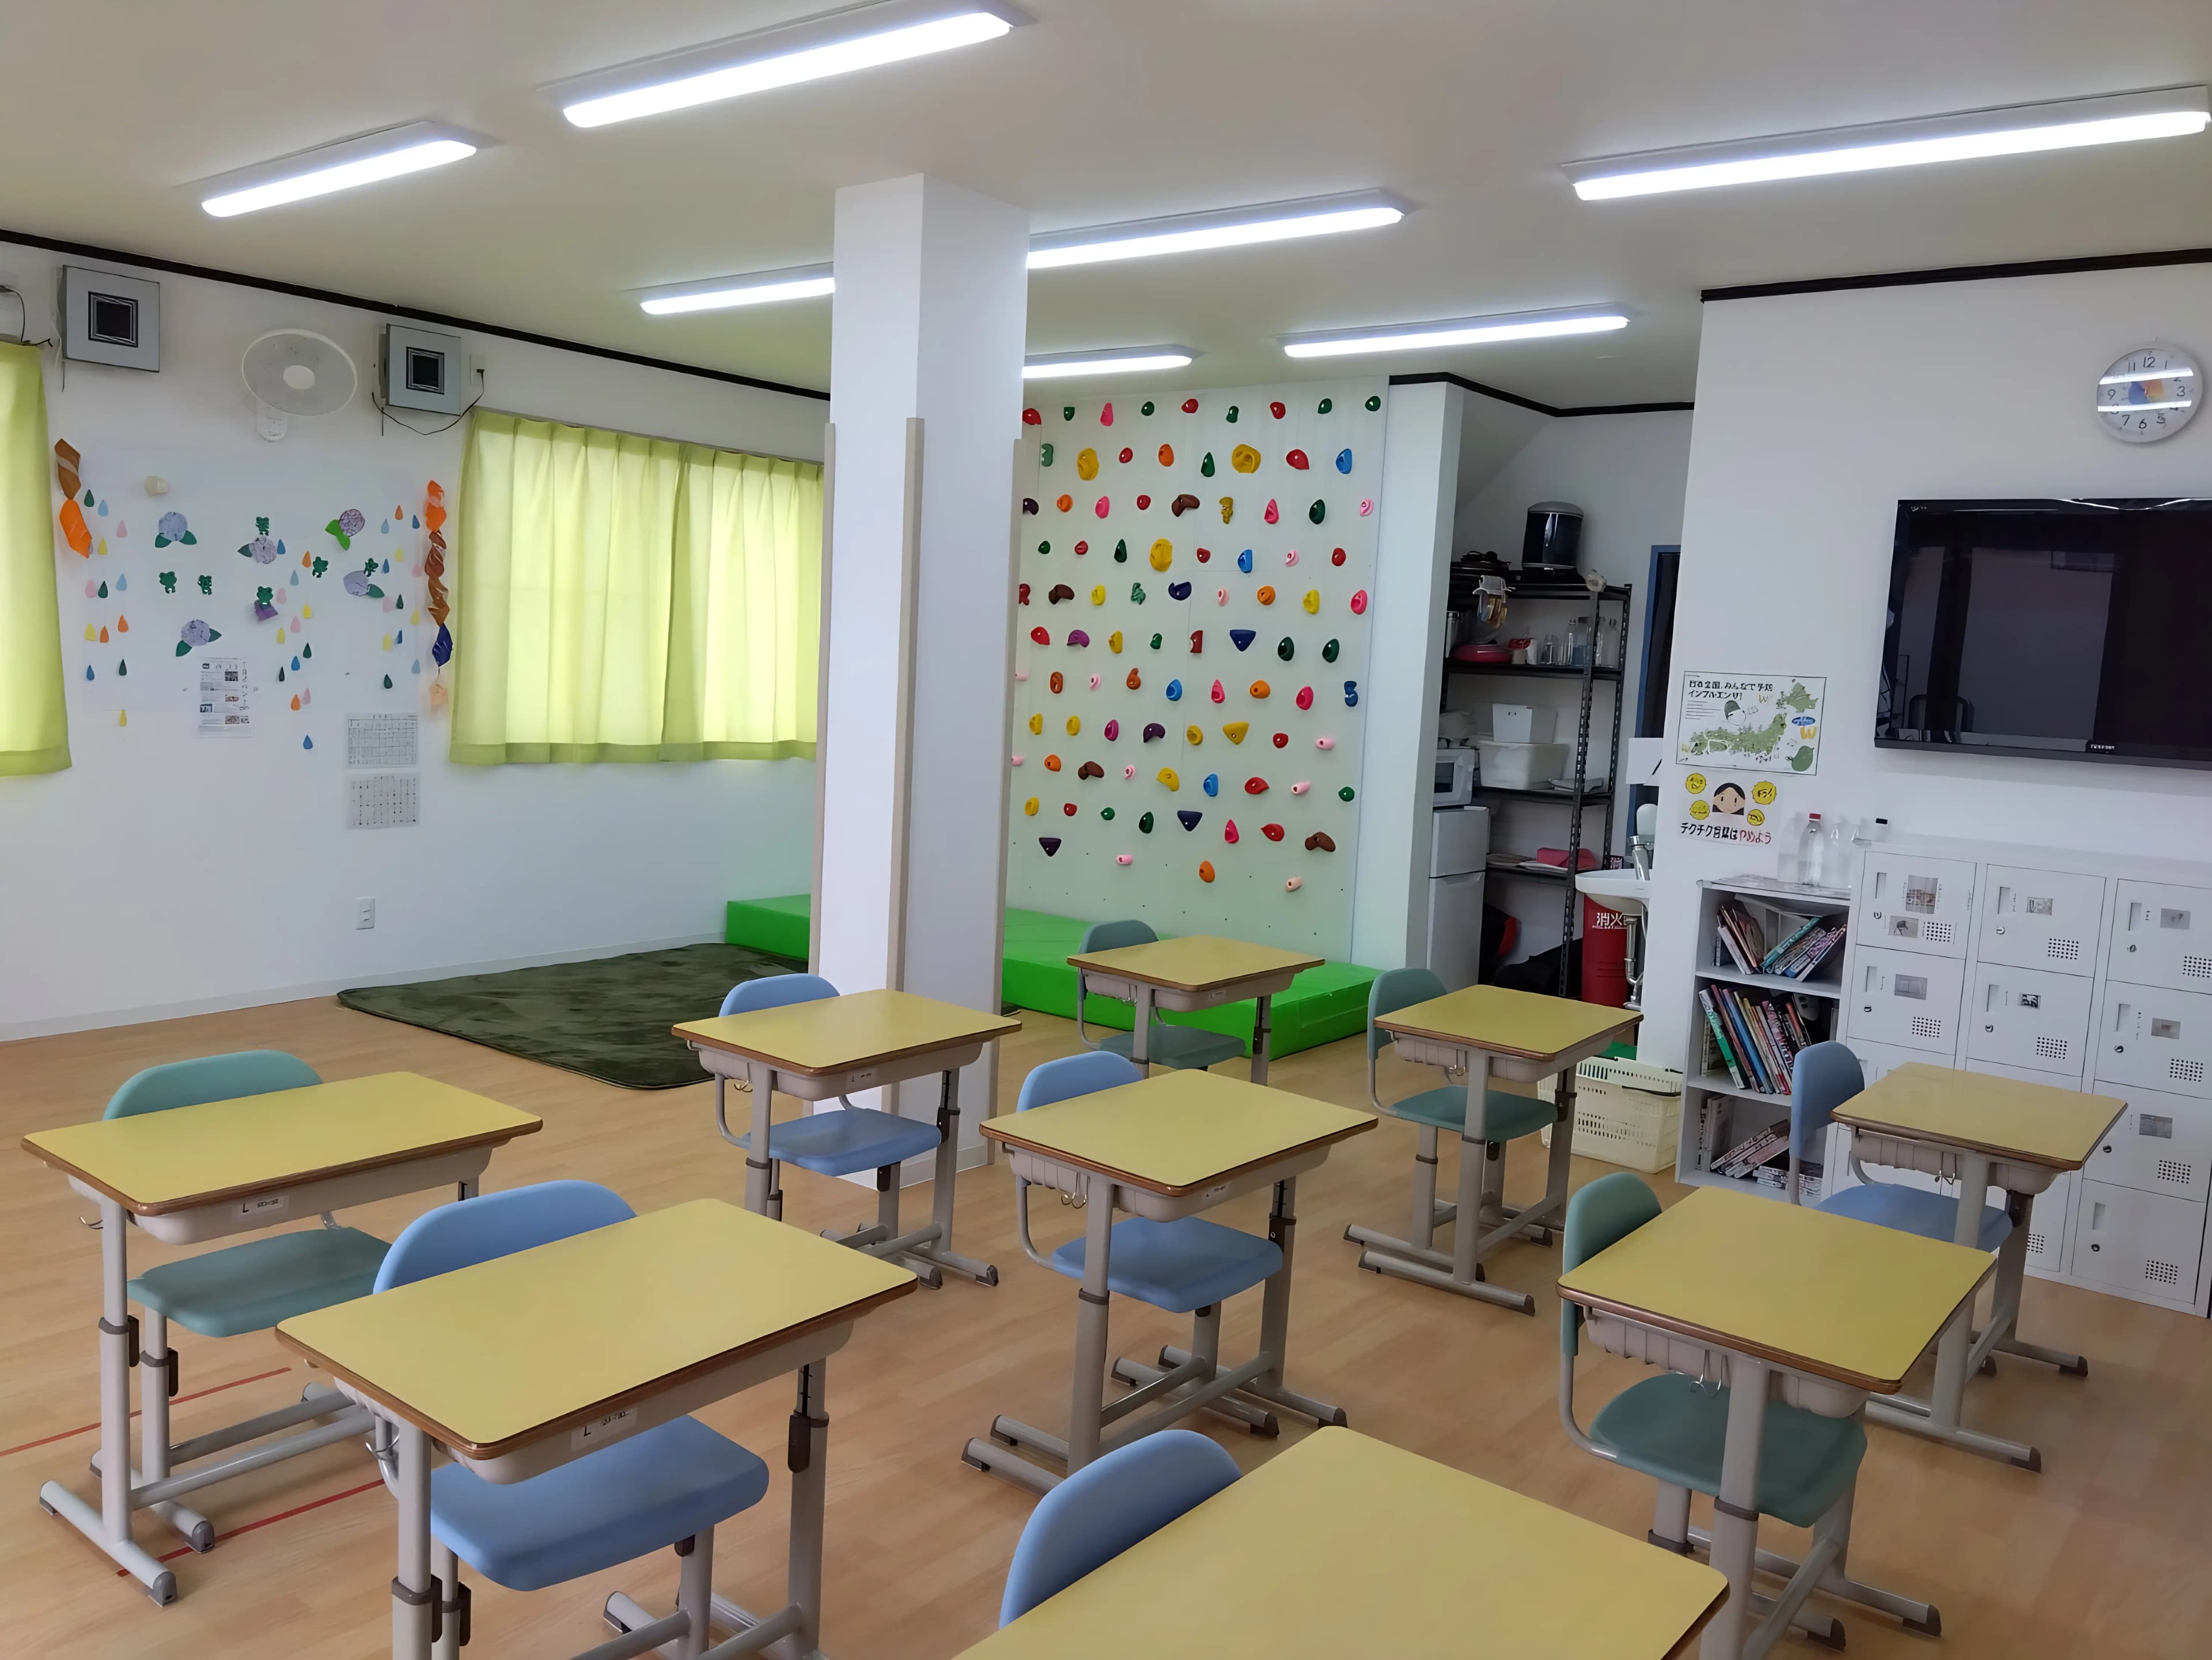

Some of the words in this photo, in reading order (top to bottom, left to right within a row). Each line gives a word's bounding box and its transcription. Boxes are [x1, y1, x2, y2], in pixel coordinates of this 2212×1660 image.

[2128, 362, 2135, 372] 11
[2143, 357, 2155, 368] 12
[2108, 390, 2116, 399] 9
[2176, 386, 2186, 396] 3
[2122, 415, 2130, 426] 7
[2139, 418, 2147, 429] 6
[242, 1203, 249, 1213] L
[584, 1425, 591, 1436] L
